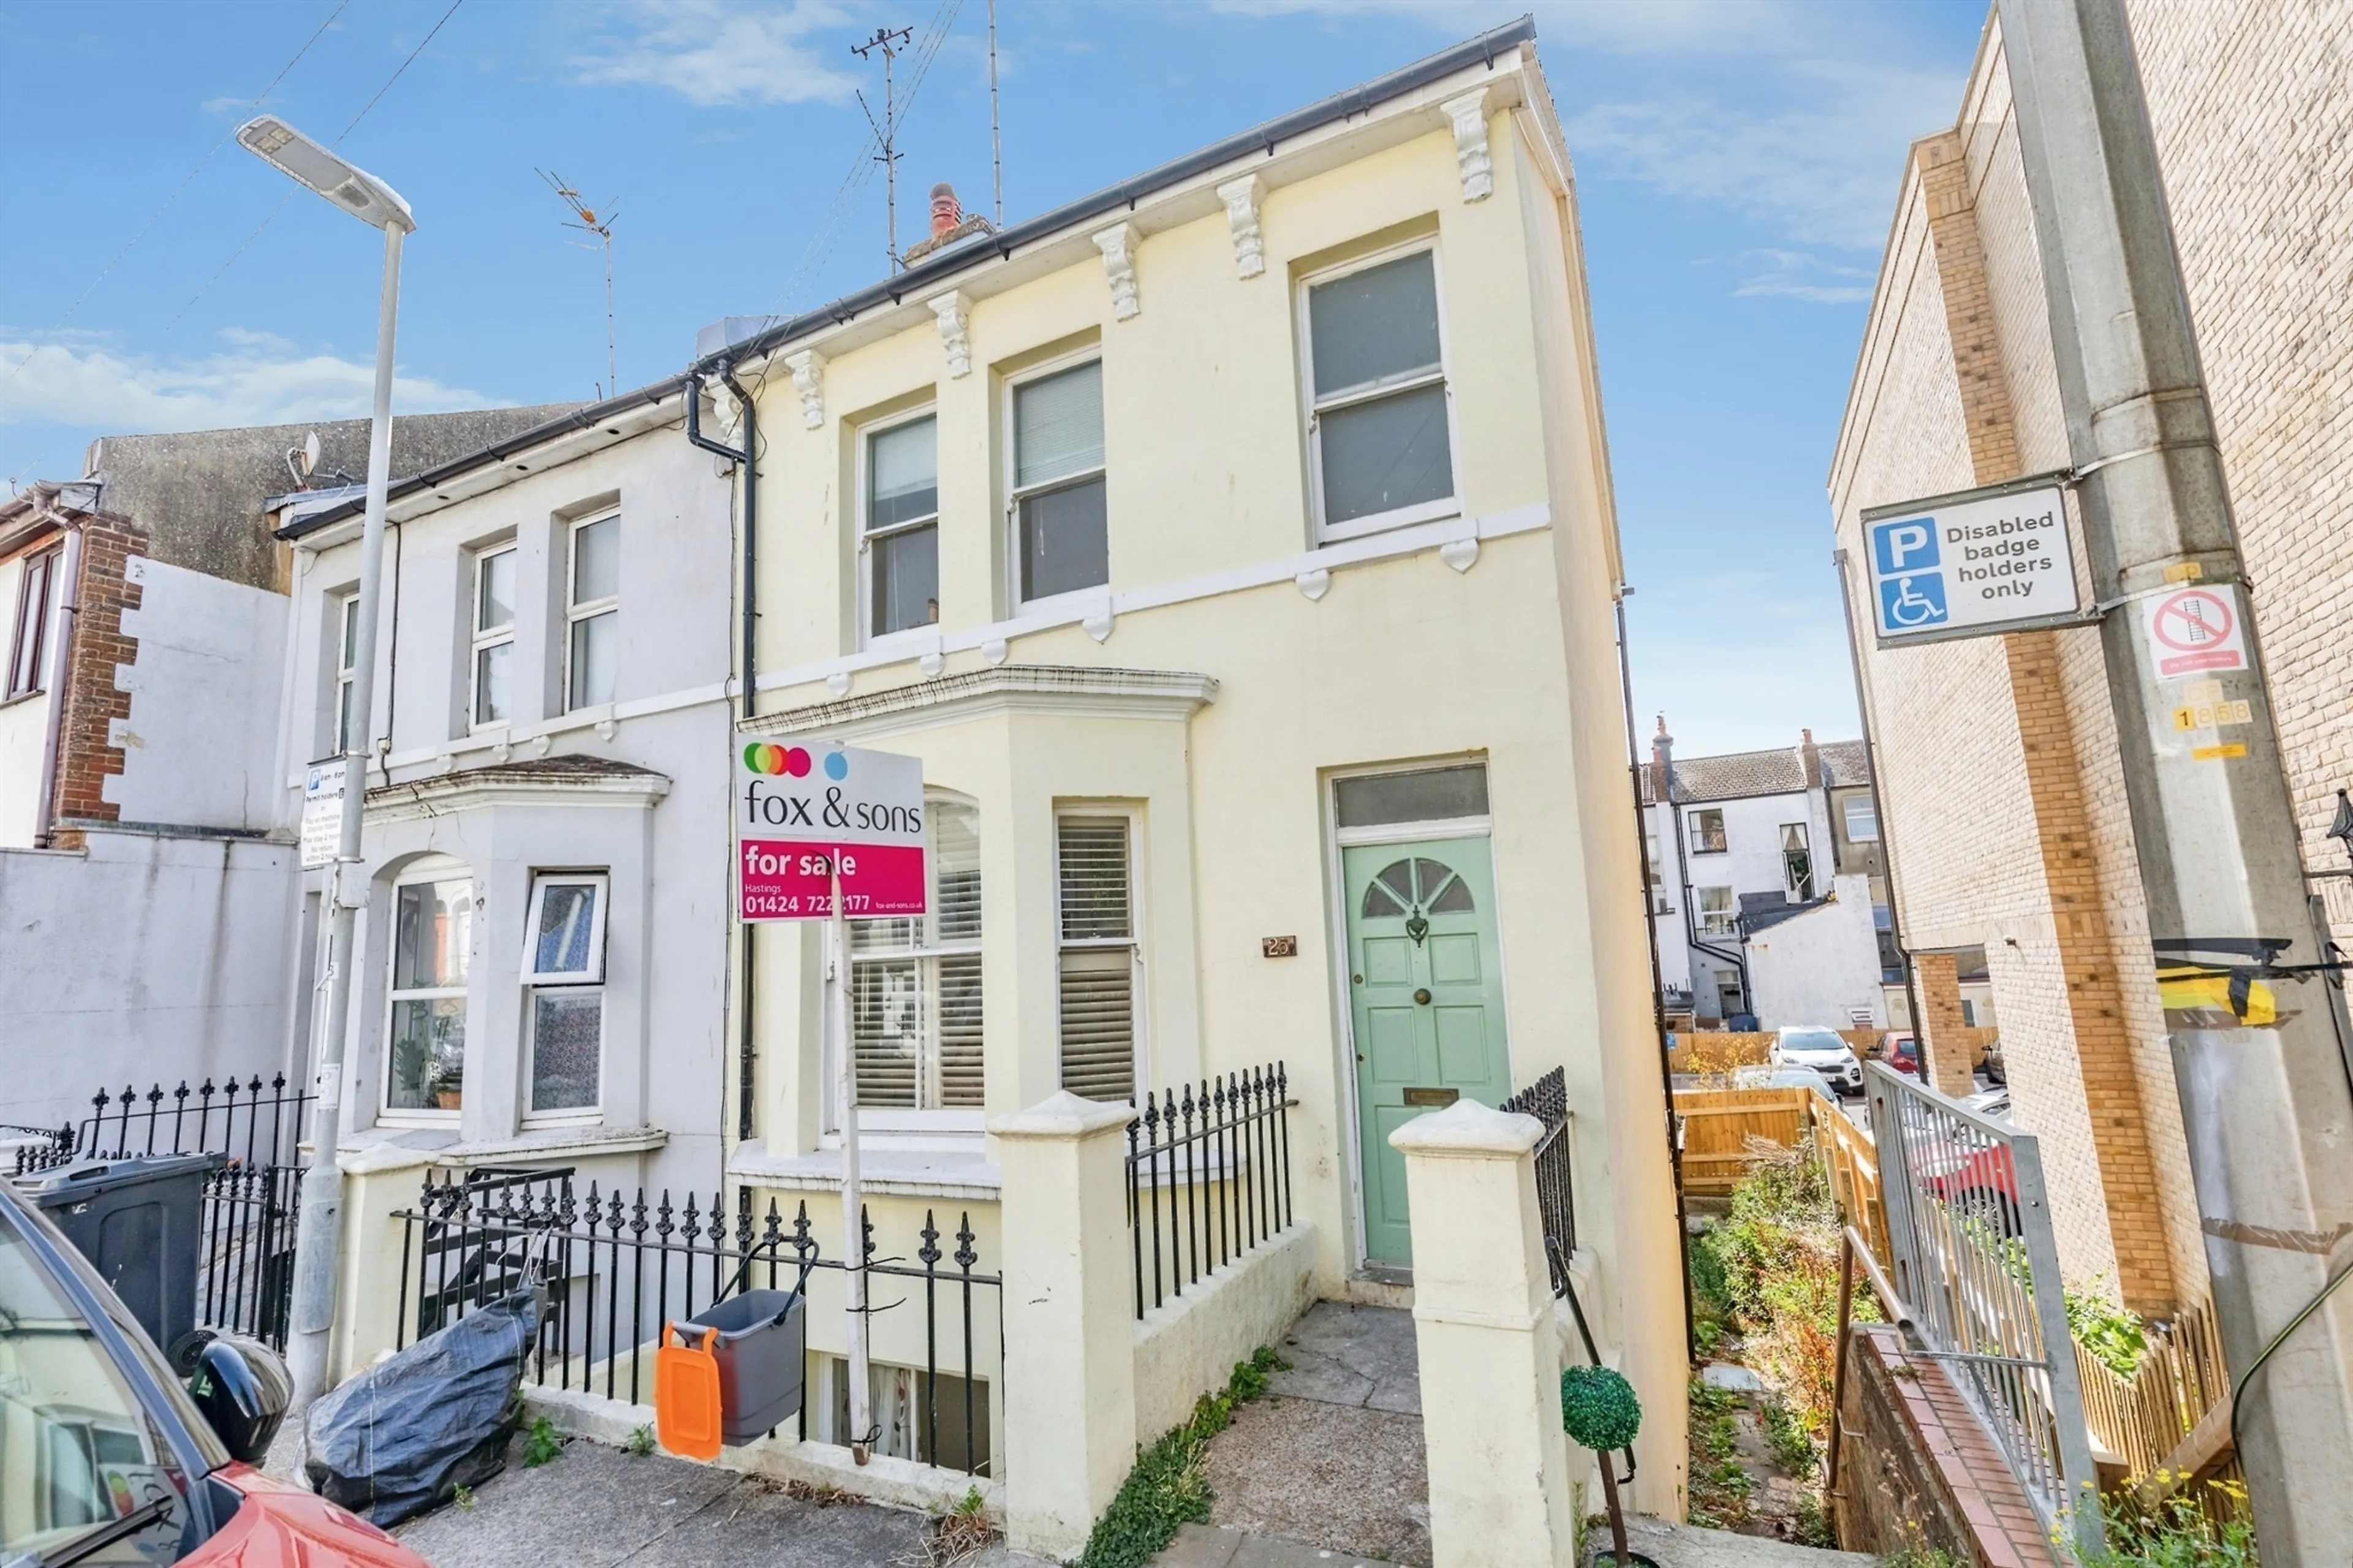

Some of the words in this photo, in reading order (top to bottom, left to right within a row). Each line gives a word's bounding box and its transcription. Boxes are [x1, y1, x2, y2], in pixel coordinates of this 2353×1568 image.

[1947, 512, 2053, 543] Disabled
[1889, 525, 1928, 569] P
[1965, 539, 2040, 561] badge
[1959, 556, 2052, 582] holders
[1982, 580, 2033, 599] only
[745, 780, 814, 826] fox
[822, 787, 851, 828] &
[857, 803, 921, 833] sons
[745, 846, 791, 875] for
[799, 848, 856, 876] sale
[745, 884, 781, 895] Hastings
[746, 896, 799, 913] 01424
[1268, 938, 1289, 956] 25
